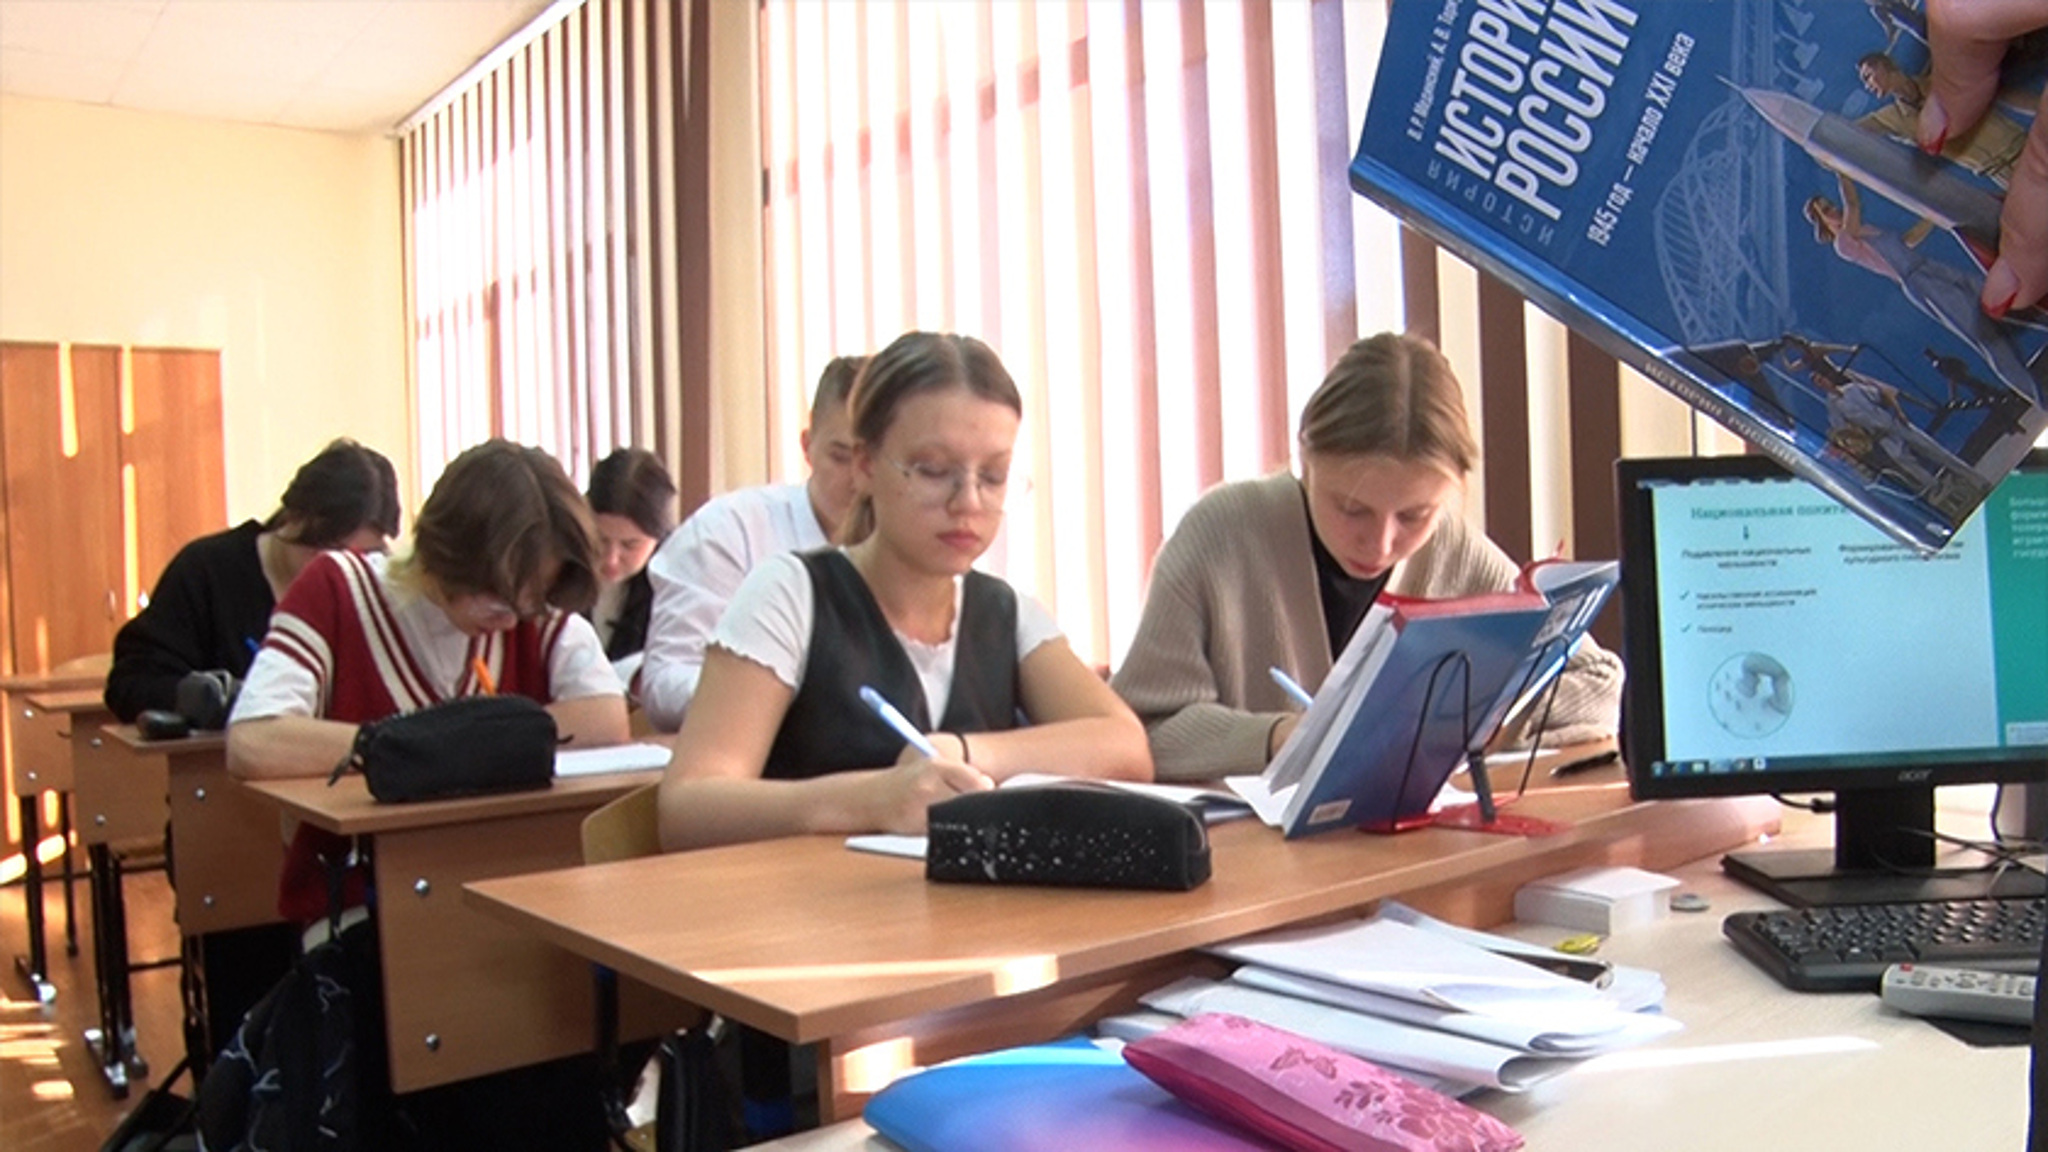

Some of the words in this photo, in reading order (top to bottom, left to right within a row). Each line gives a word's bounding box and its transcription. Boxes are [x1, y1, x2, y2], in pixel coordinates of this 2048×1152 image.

[1434, 0, 1549, 181] ИСТОРИ
[1494, 0, 1639, 220] РОССИИ
[1586, 207, 1618, 247] 1945
[1606, 183, 1634, 213] год
[1626, 106, 1663, 165] начало
[1645, 71, 1677, 109] XXI
[1664, 32, 1695, 77] века
[1427, 159, 1555, 246] ИСТОРИЯ
